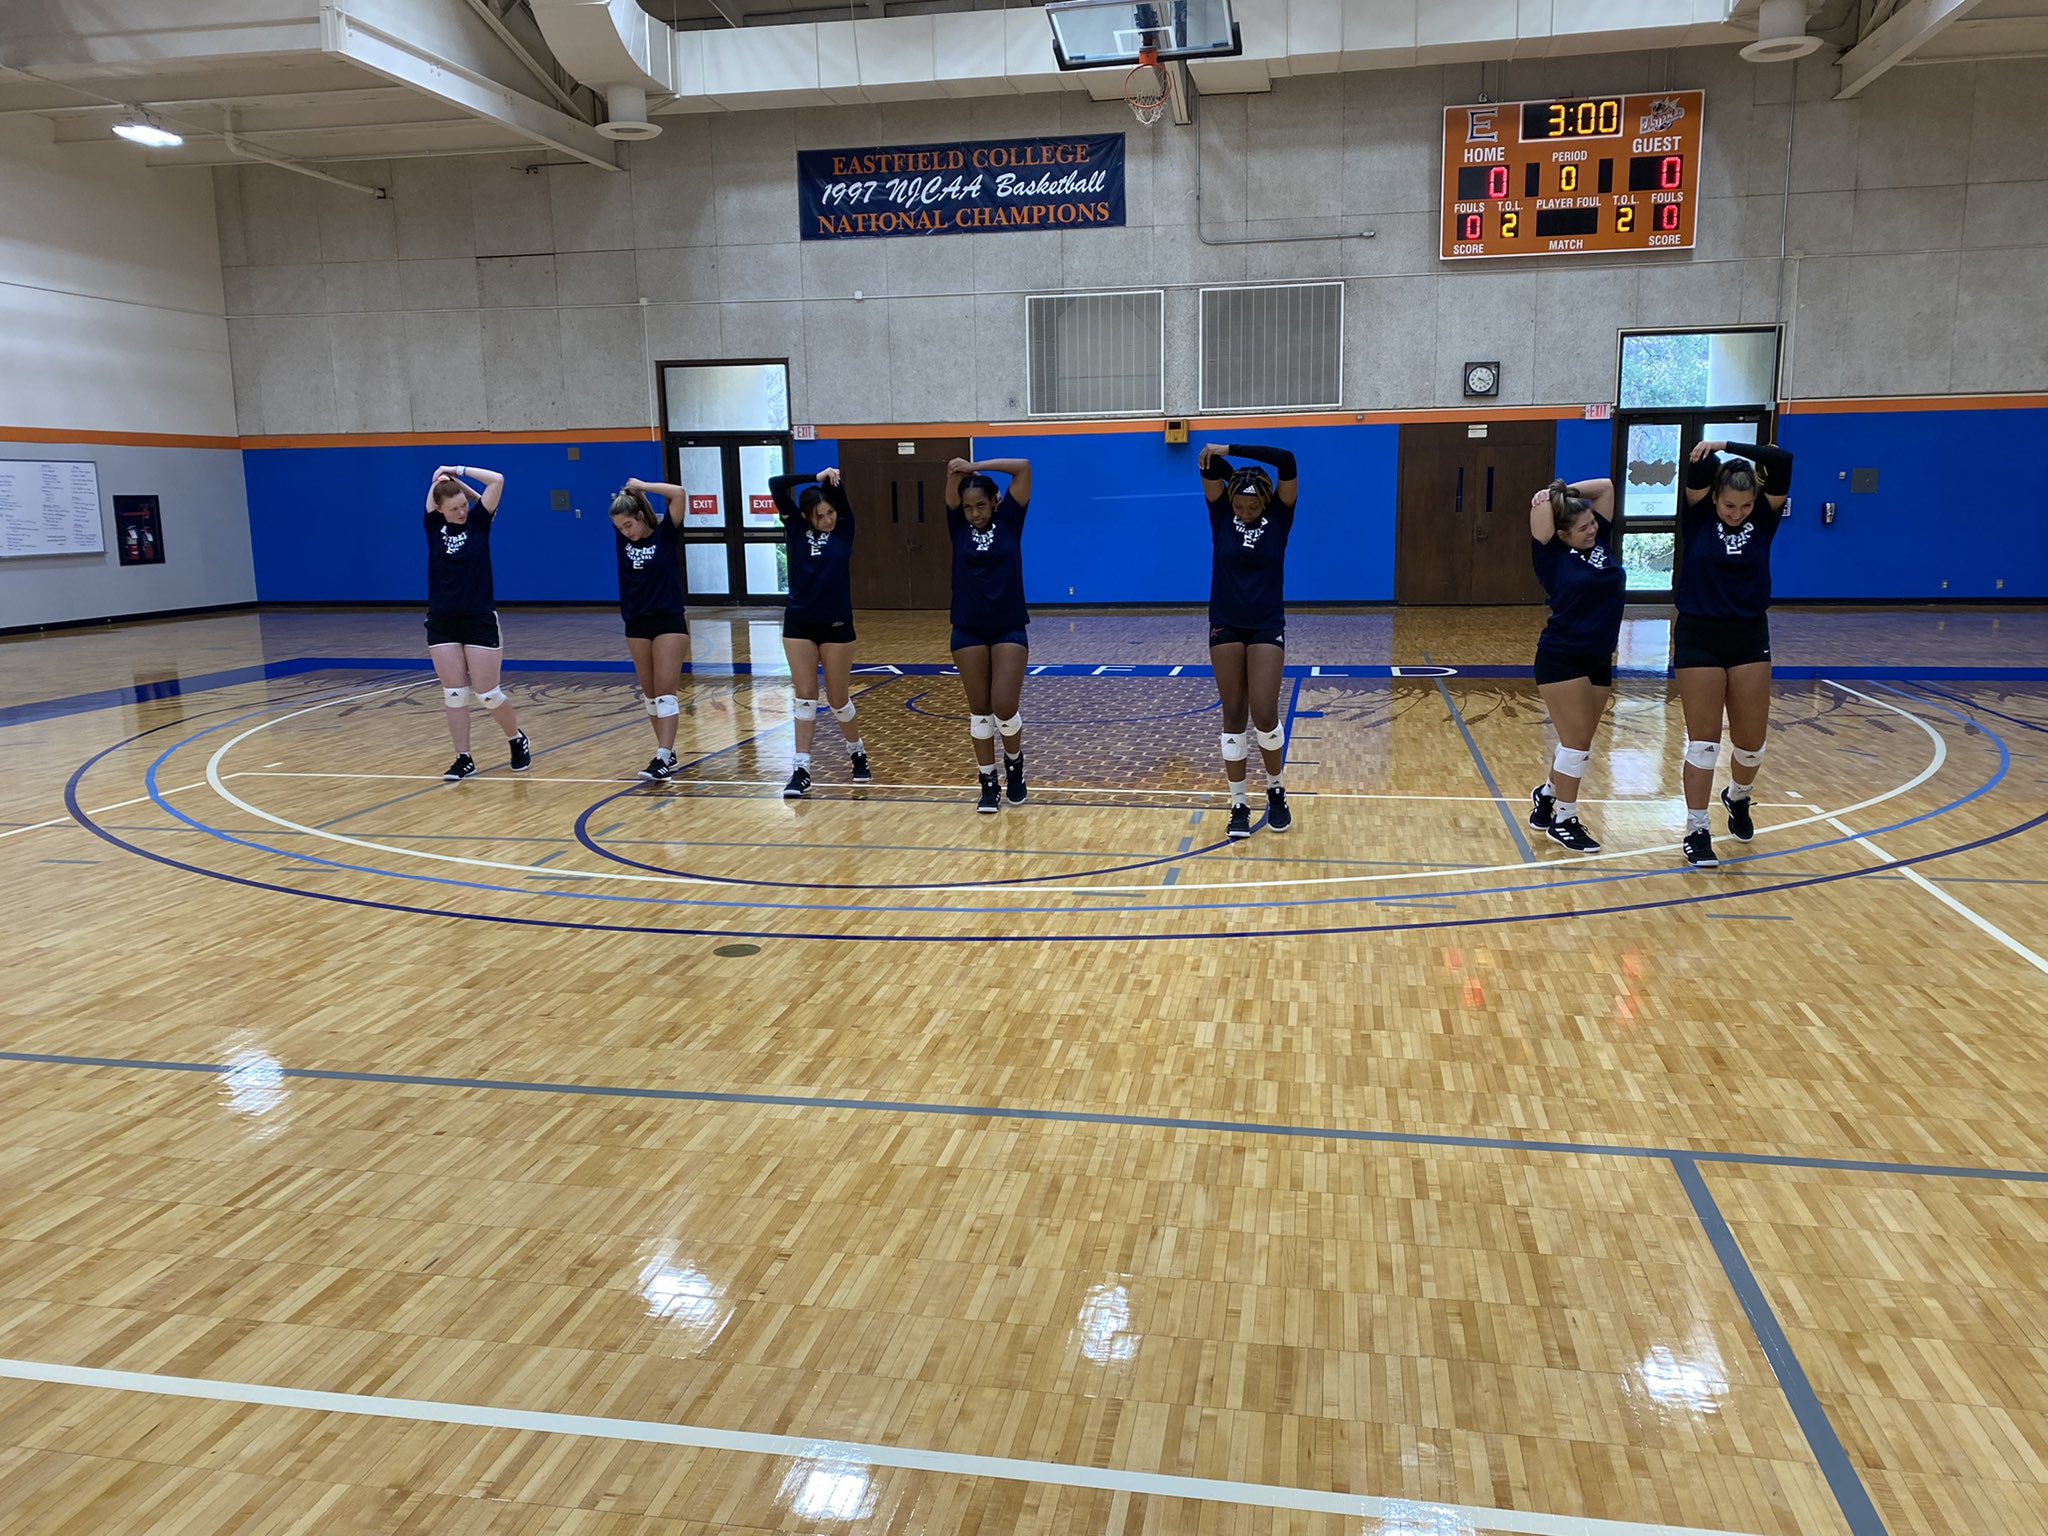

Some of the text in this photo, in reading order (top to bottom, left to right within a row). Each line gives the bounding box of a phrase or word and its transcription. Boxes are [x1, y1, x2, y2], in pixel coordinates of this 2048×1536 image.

[1465, 107, 1499, 143] E
[1549, 101, 1618, 137] 3:00
[1632, 135, 1682, 153] GUEST
[832, 143, 1090, 176] EASTFIELD COLLEGE
[1464, 147, 1505, 163] HOME
[1552, 151, 1588, 162] PERIOD
[1561, 165, 1576, 191] 0
[1661, 156, 1681, 188] 0
[821, 169, 1107, 208] 1997 NJCAA Basketball
[1488, 166, 1508, 198] 0
[1536, 196, 1601, 209] PLAYER FOUL
[1651, 192, 1684, 204] FOULS
[1454, 202, 1485, 213] FOULS
[817, 201, 1110, 234] NATIONAL CHAMPIONS
[1502, 212, 1517, 238] 2
[1616, 207, 1633, 233] 2
[1662, 204, 1678, 230] 0
[1465, 214, 1481, 240] 0
[1453, 244, 1484, 255] SCORE
[1549, 240, 1584, 250] MATCH
[1648, 235, 1681, 246] SCORE
[1590, 405, 1607, 417] EXIT
[797, 426, 813, 438] EXIT
[693, 500, 713, 509] EXIT
[753, 499, 774, 509] EXIT
